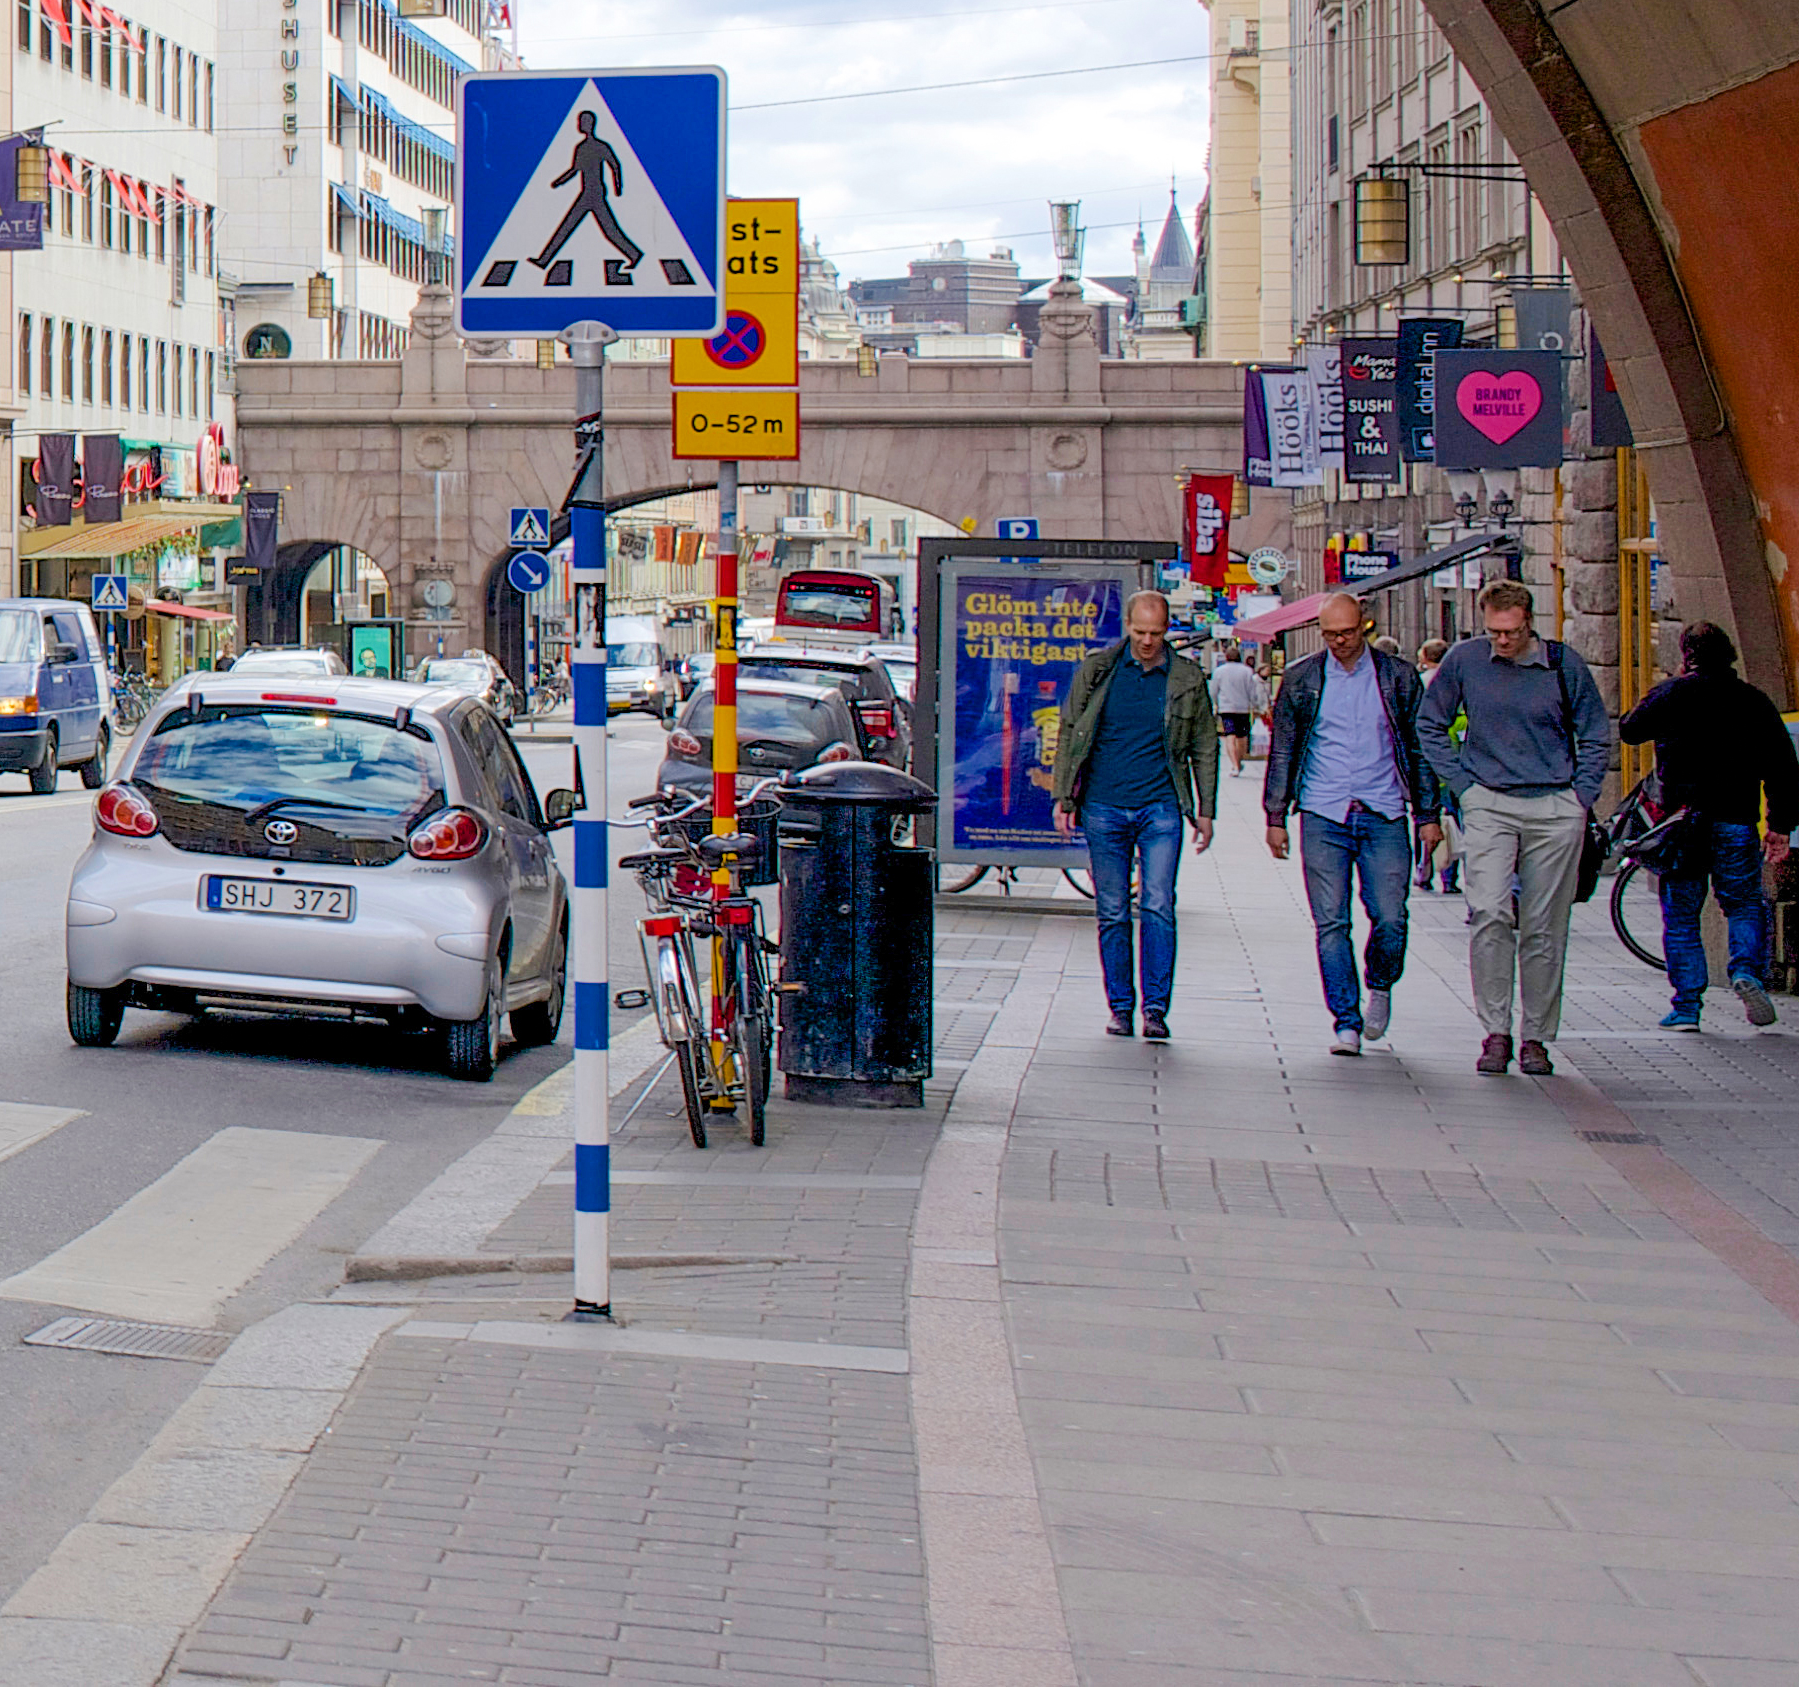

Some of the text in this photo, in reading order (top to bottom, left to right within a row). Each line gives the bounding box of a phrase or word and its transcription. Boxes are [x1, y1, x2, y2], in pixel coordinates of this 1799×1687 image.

[730, 217, 781, 242] st-
[727, 251, 779, 274] ats
[1353, 354, 1397, 367] Mama
[1474, 388, 1522, 401] BRANDY
[1347, 398, 1393, 413] SUSHI
[1472, 403, 1526, 416] MELVILLE
[690, 414, 782, 434] 0-52 m
[1274, 384, 1303, 476] Hööks
[1359, 415, 1382, 439] &
[1353, 441, 1389, 456] THAI
[1195, 492, 1225, 554] siba
[1052, 542, 1140, 556] TELEFON
[1344, 554, 1389, 565] Phone
[965, 593, 1098, 618] Glöm inte
[965, 616, 1097, 640] packa det
[224, 885, 340, 913] SHJ 372
